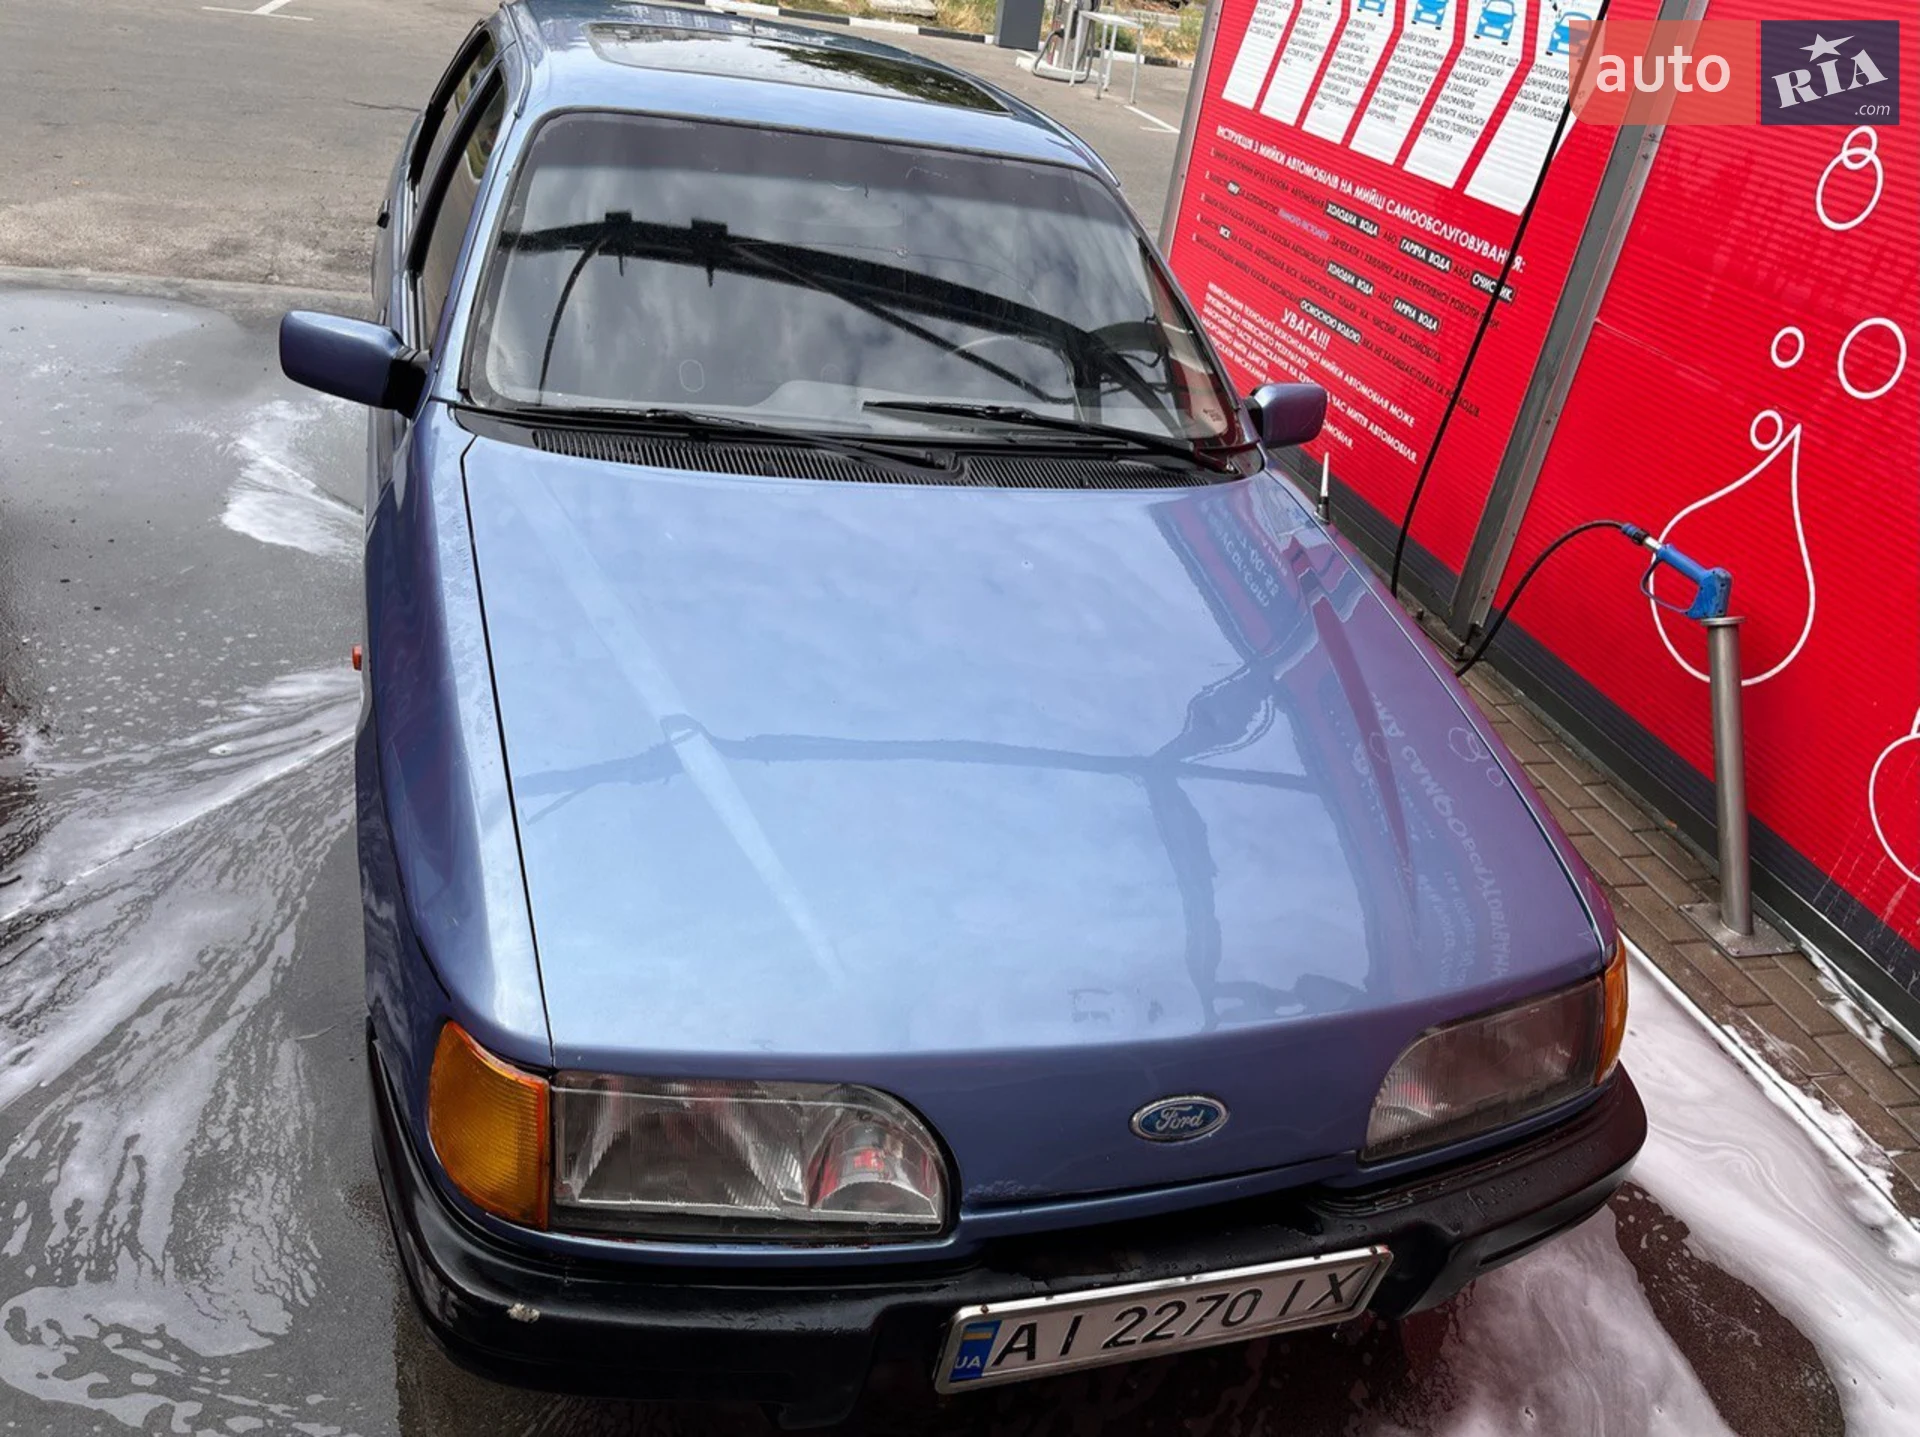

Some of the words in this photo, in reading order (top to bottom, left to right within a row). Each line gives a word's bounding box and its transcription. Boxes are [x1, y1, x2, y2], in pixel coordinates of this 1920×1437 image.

[1259, 144, 1286, 165] МИЙКИ
[1285, 156, 1339, 189] АВТОМОБІЛІВ
[1340, 179, 1353, 195] НА
[1386, 199, 1526, 273] САМООБСЛУГОВУВАНЯ:
[1359, 219, 1378, 237] ВОДА
[1400, 239, 1426, 260] ГАРЯЧА
[1428, 252, 1451, 272] ВОДА
[1281, 307, 1331, 351] УВАГА!!!
[1356, 279, 1374, 295] ВОДА
[1393, 299, 1417, 320] ГАРЯЧА
[1418, 313, 1438, 331] ВОДА
[1344, 374, 1390, 410] АВТОМОБІЛЯ
[1389, 404, 1416, 428] МОЖЕ
[1332, 394, 1347, 412] ЧАС
[1346, 406, 1369, 428] МИТТЯ
[1368, 422, 1417, 464] АВТОМОБІЛЯ.
[1156, 1105, 1204, 1131] Ford
[989, 1314, 1084, 1367] AI
[1102, 1288, 1264, 1350] 2270
[954, 1355, 981, 1370] UA
